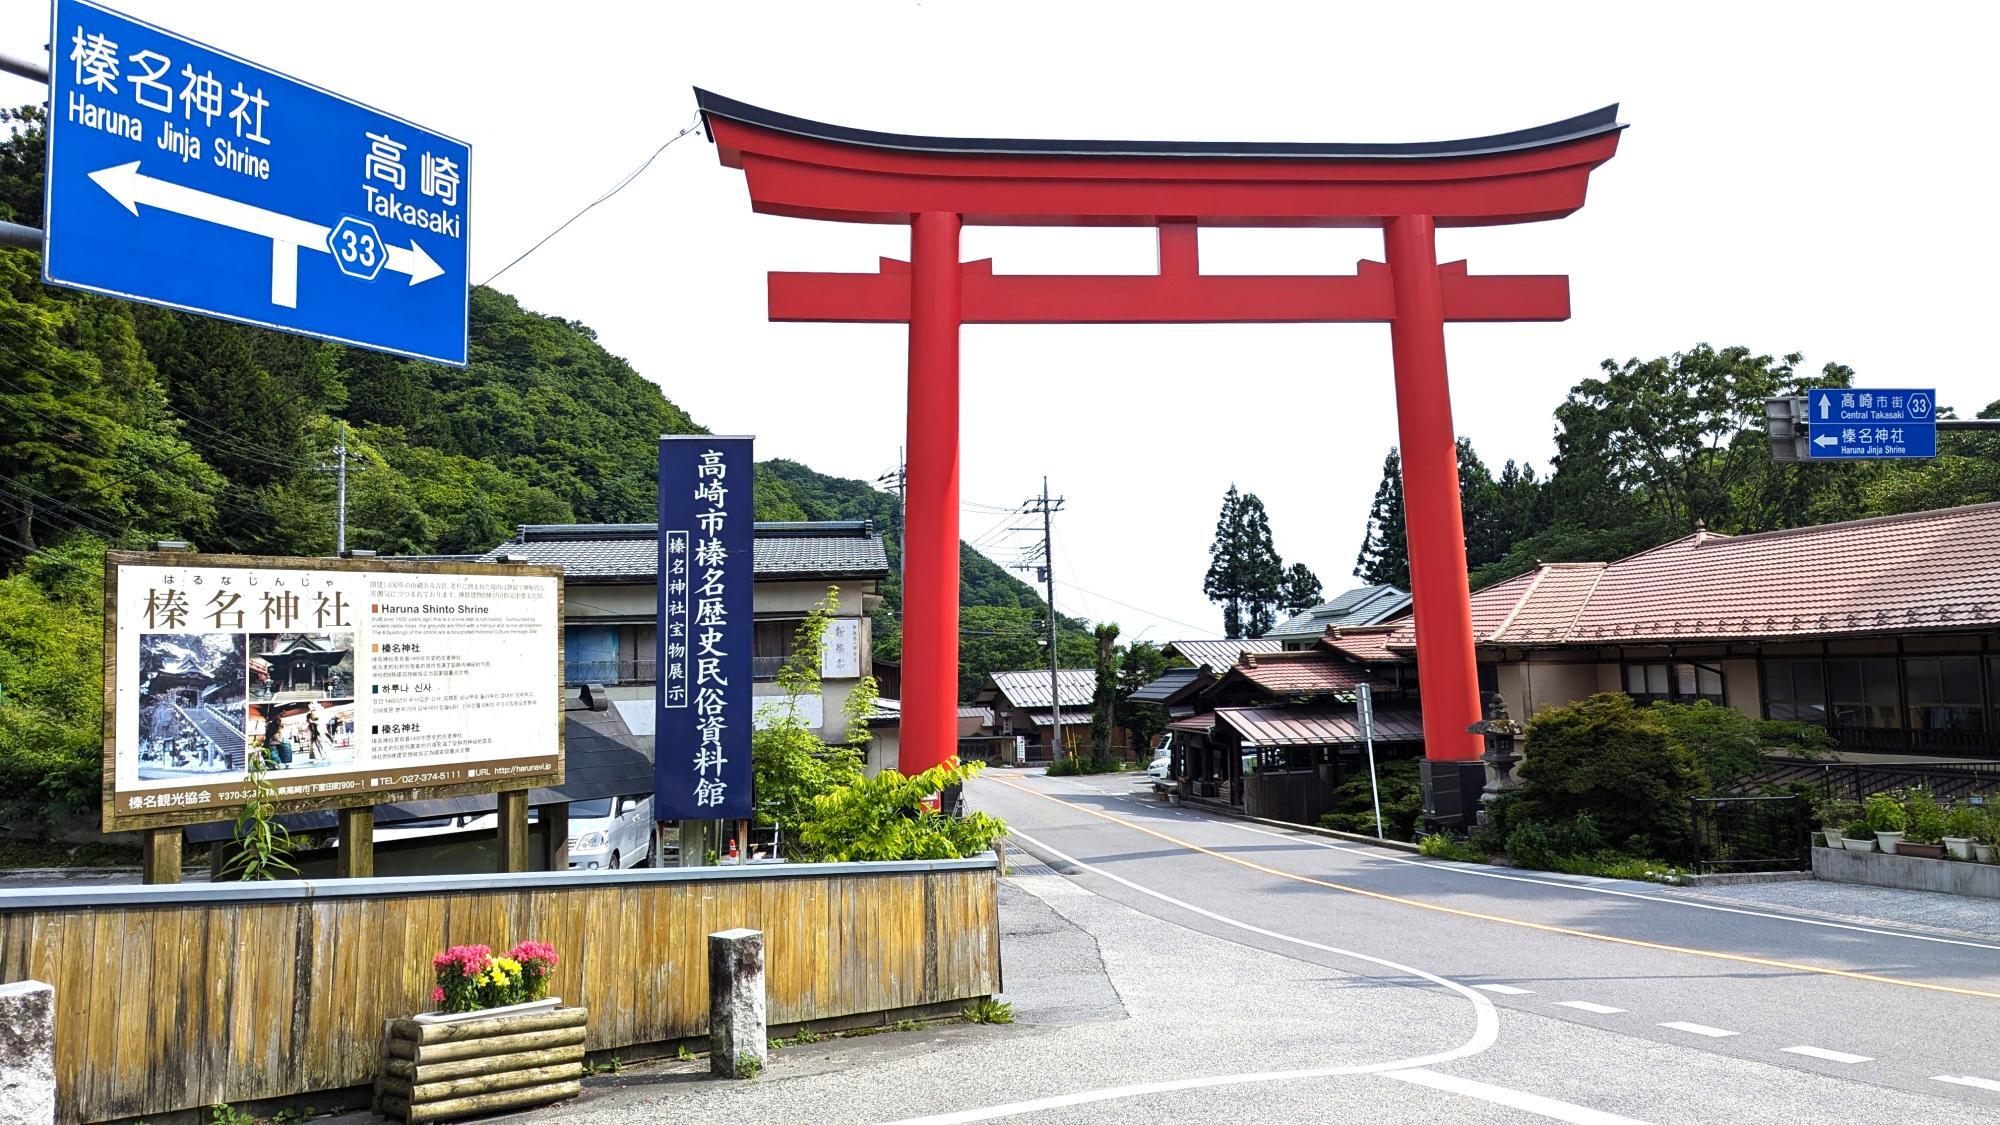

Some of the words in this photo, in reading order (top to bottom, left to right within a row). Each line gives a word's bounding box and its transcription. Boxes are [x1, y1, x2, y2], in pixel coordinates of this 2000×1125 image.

[70, 26, 271, 146] 榛名神社
[68, 91, 142, 142] Haruna
[156, 120, 201, 163] Jinja
[214, 138, 270, 181] Shrine
[365, 131, 460, 207] 高崎
[362, 184, 460, 239] Takasaki
[341, 229, 375, 268] 33
[1841, 393, 1903, 409] 高崎市街
[1912, 399, 1926, 413] 33
[1841, 410, 1868, 420] Central
[1871, 410, 1905, 420] Takasaki
[1842, 427, 1905, 444] 榛名神社
[1841, 445, 1865, 455] Haruna
[1867, 445, 1883, 456] Jinja
[1884, 445, 1906, 454] Shrine
[163, 574, 334, 587] はるなじんじゃ
[142, 587, 352, 630] 榛名神社
[381, 603, 420, 614] Haruna
[422, 604, 455, 614] Shinto
[457, 604, 489, 614] Shrine
[668, 536, 687, 703] 榛名神社宝物展示
[692, 448, 729, 808] 高崎市榛名歴史民俗資料館
[382, 643, 420, 653] 榛名神社
[382, 684, 409, 693] 하루나
[414, 682, 432, 693] 신사
[382, 723, 420, 734] 榛名神社
[476, 768, 490, 776] URL
[128, 789, 212, 810] 榛名観光協会
